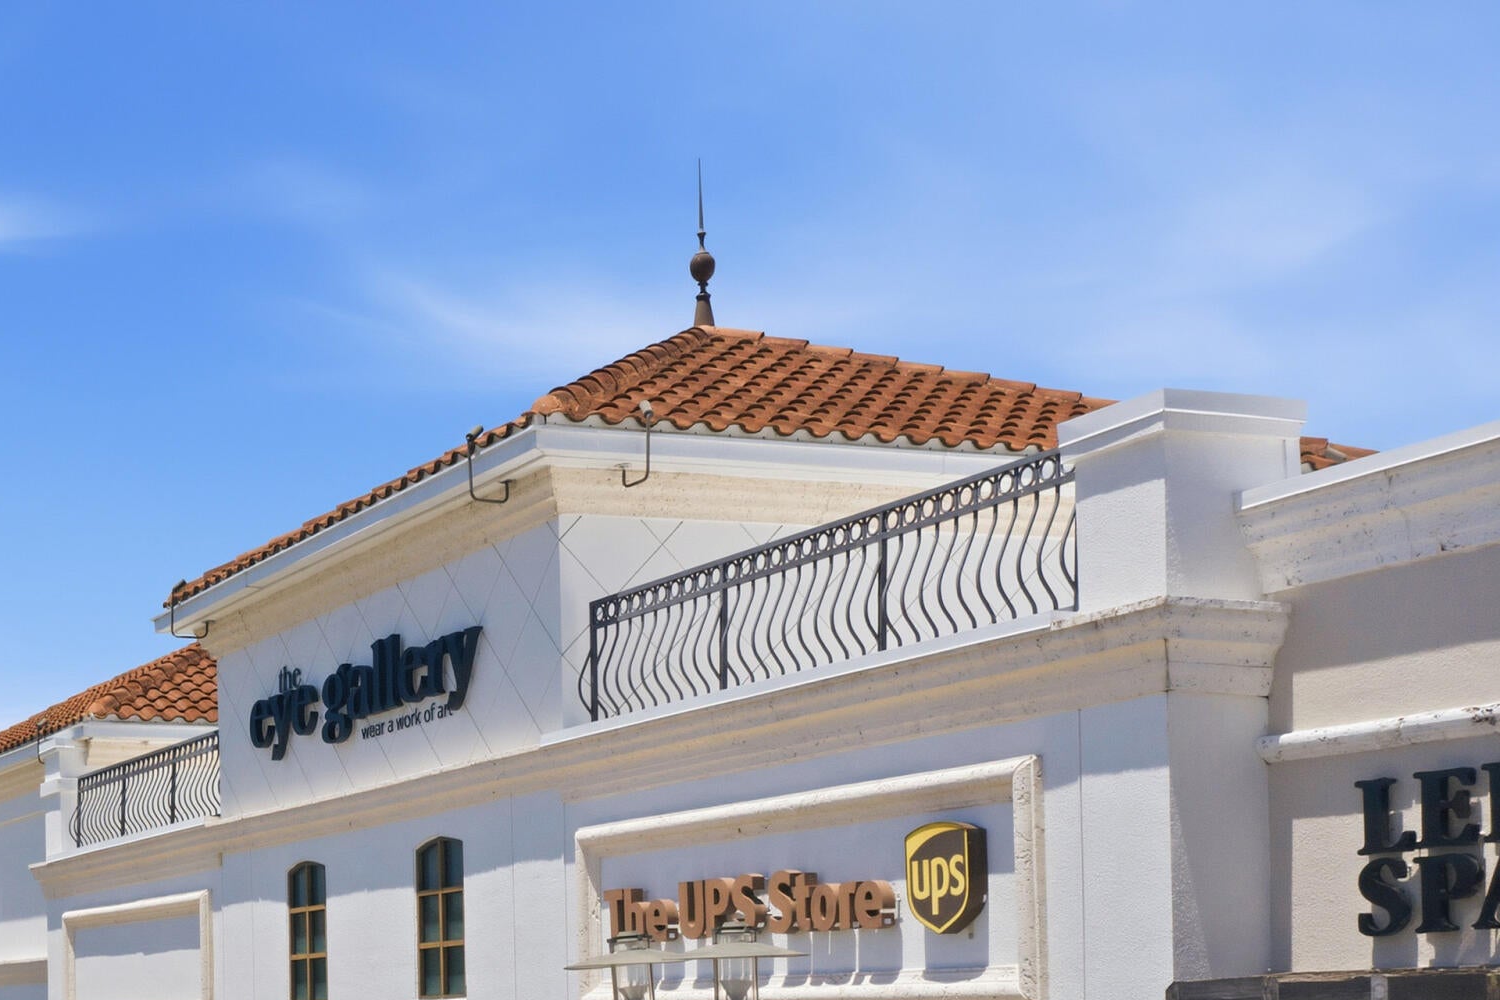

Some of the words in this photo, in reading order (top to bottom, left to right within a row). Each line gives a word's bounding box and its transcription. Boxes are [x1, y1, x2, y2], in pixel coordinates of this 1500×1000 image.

[250, 685, 319, 761] eye
[322, 626, 483, 744] gallery
[278, 666, 302, 692] the
[361, 722, 385, 740] wear
[387, 718, 394, 732] a
[395, 707, 422, 730] work
[423, 702, 436, 723] of
[437, 701, 453, 719] art
[603, 887, 678, 943] The
[678, 873, 768, 940] UPS
[767, 869, 898, 934] Store
[911, 853, 965, 916] ups
